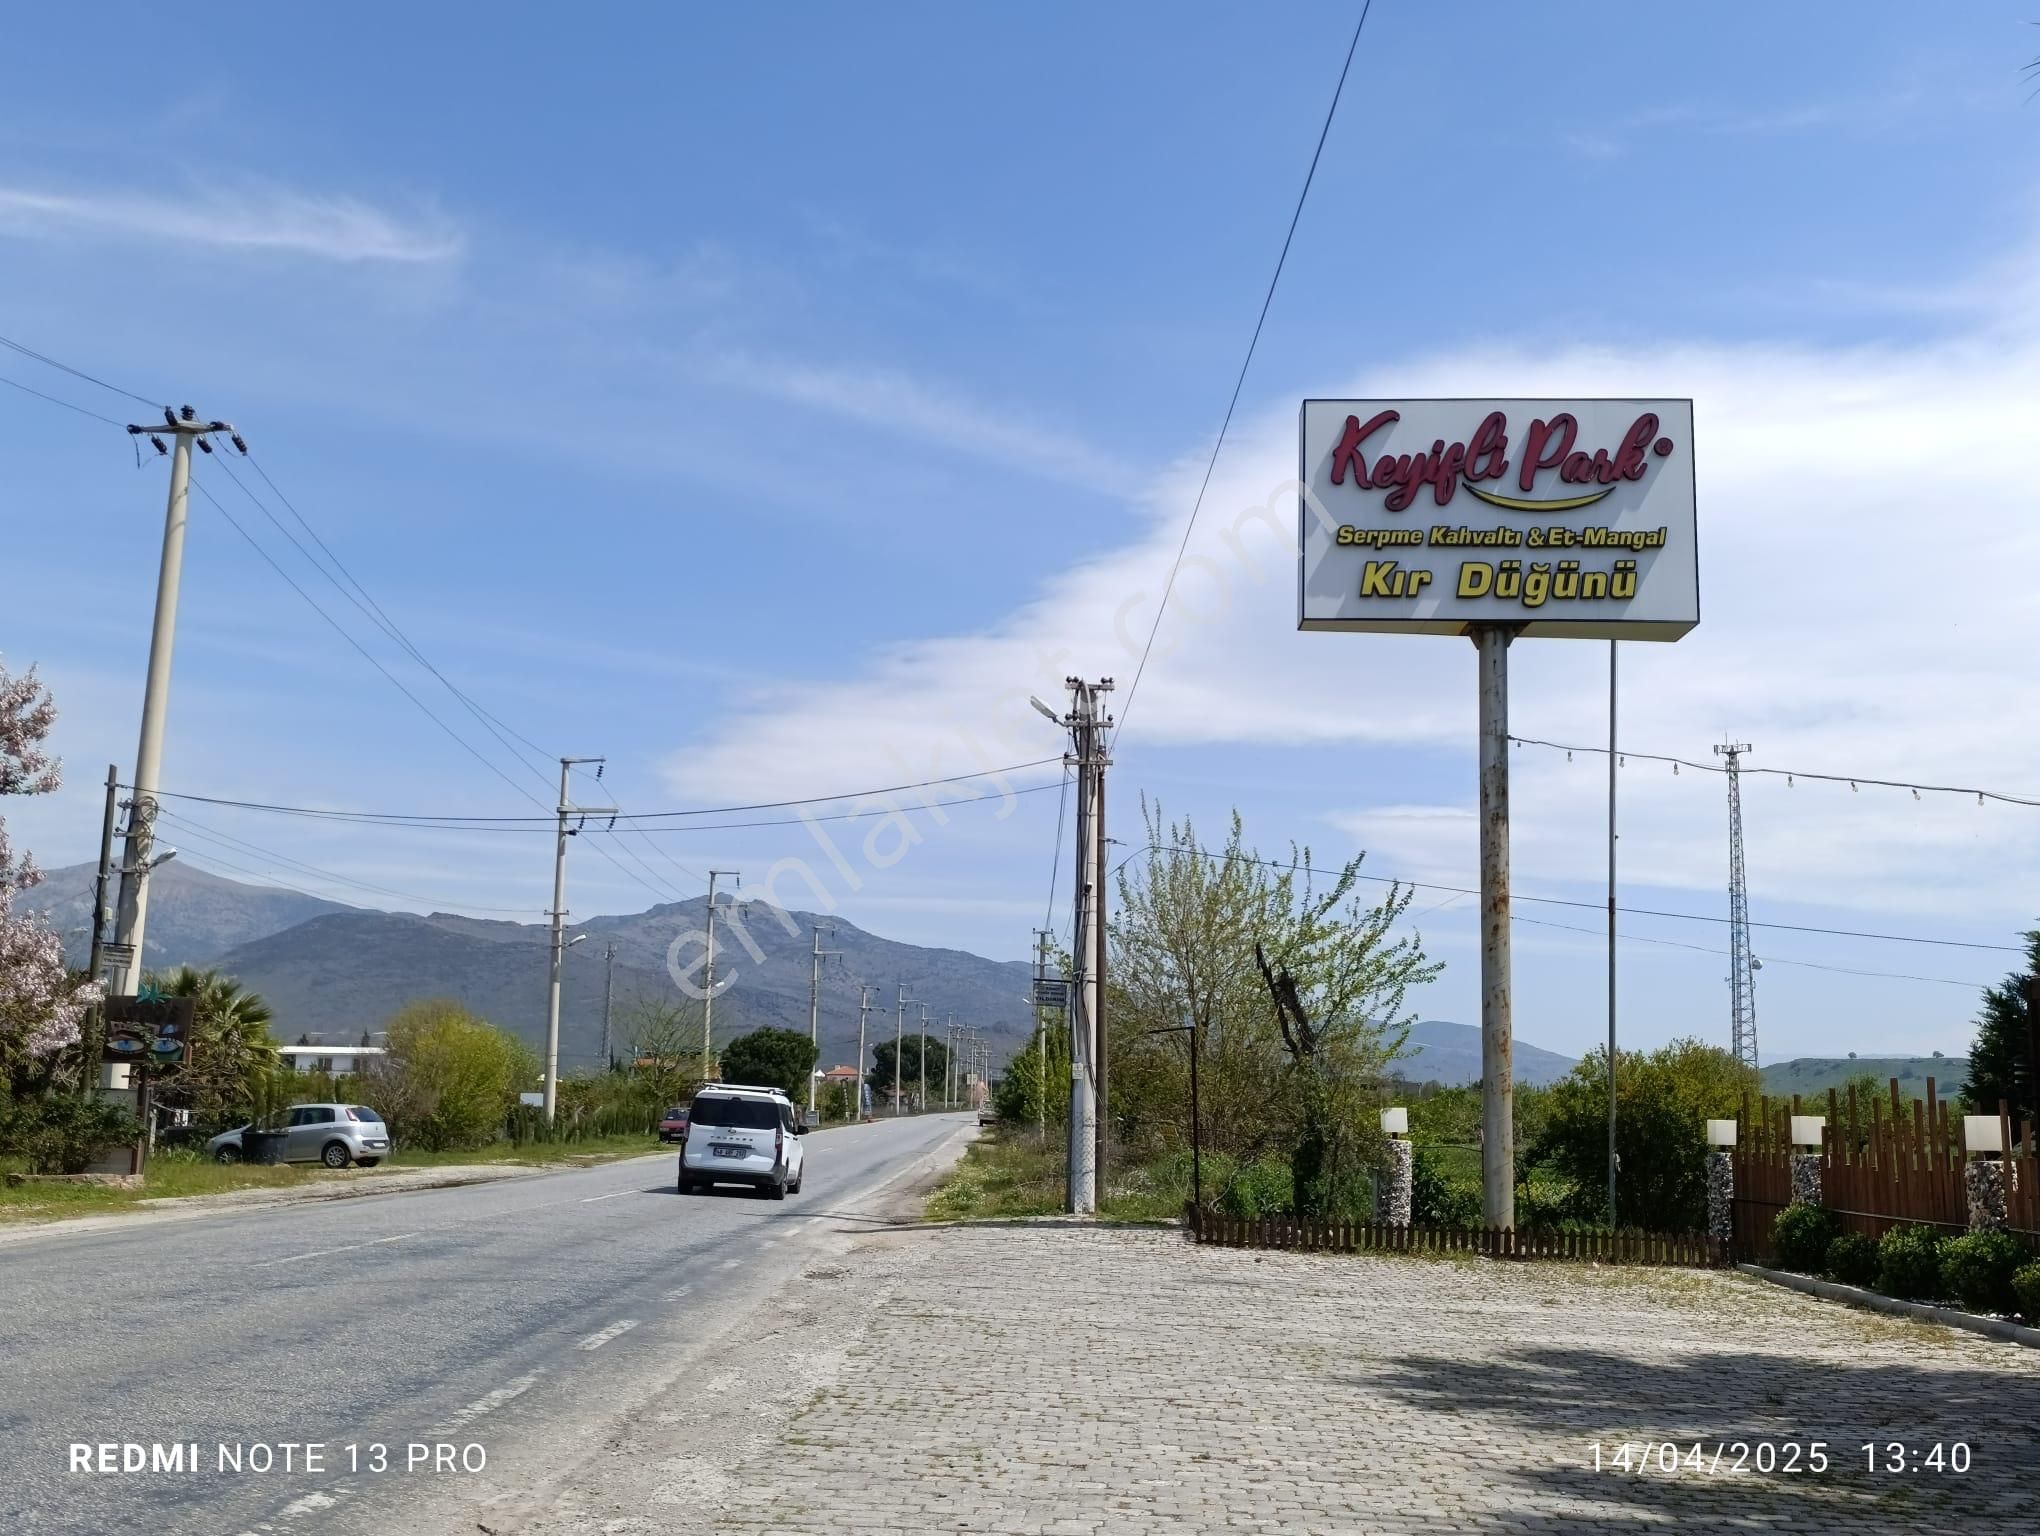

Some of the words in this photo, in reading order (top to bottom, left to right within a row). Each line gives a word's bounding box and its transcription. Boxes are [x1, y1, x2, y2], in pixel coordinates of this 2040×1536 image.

[1331, 410, 1509, 512] Keyifli
[1518, 412, 1660, 492] Park
[1336, 526, 1424, 550] Serpme
[1428, 526, 1521, 548] Kahvaltı
[1527, 527, 1545, 548] &
[1547, 527, 1668, 551] Et-Mangal
[1360, 561, 1432, 598] Kır
[1457, 560, 1638, 608] Düğünü
